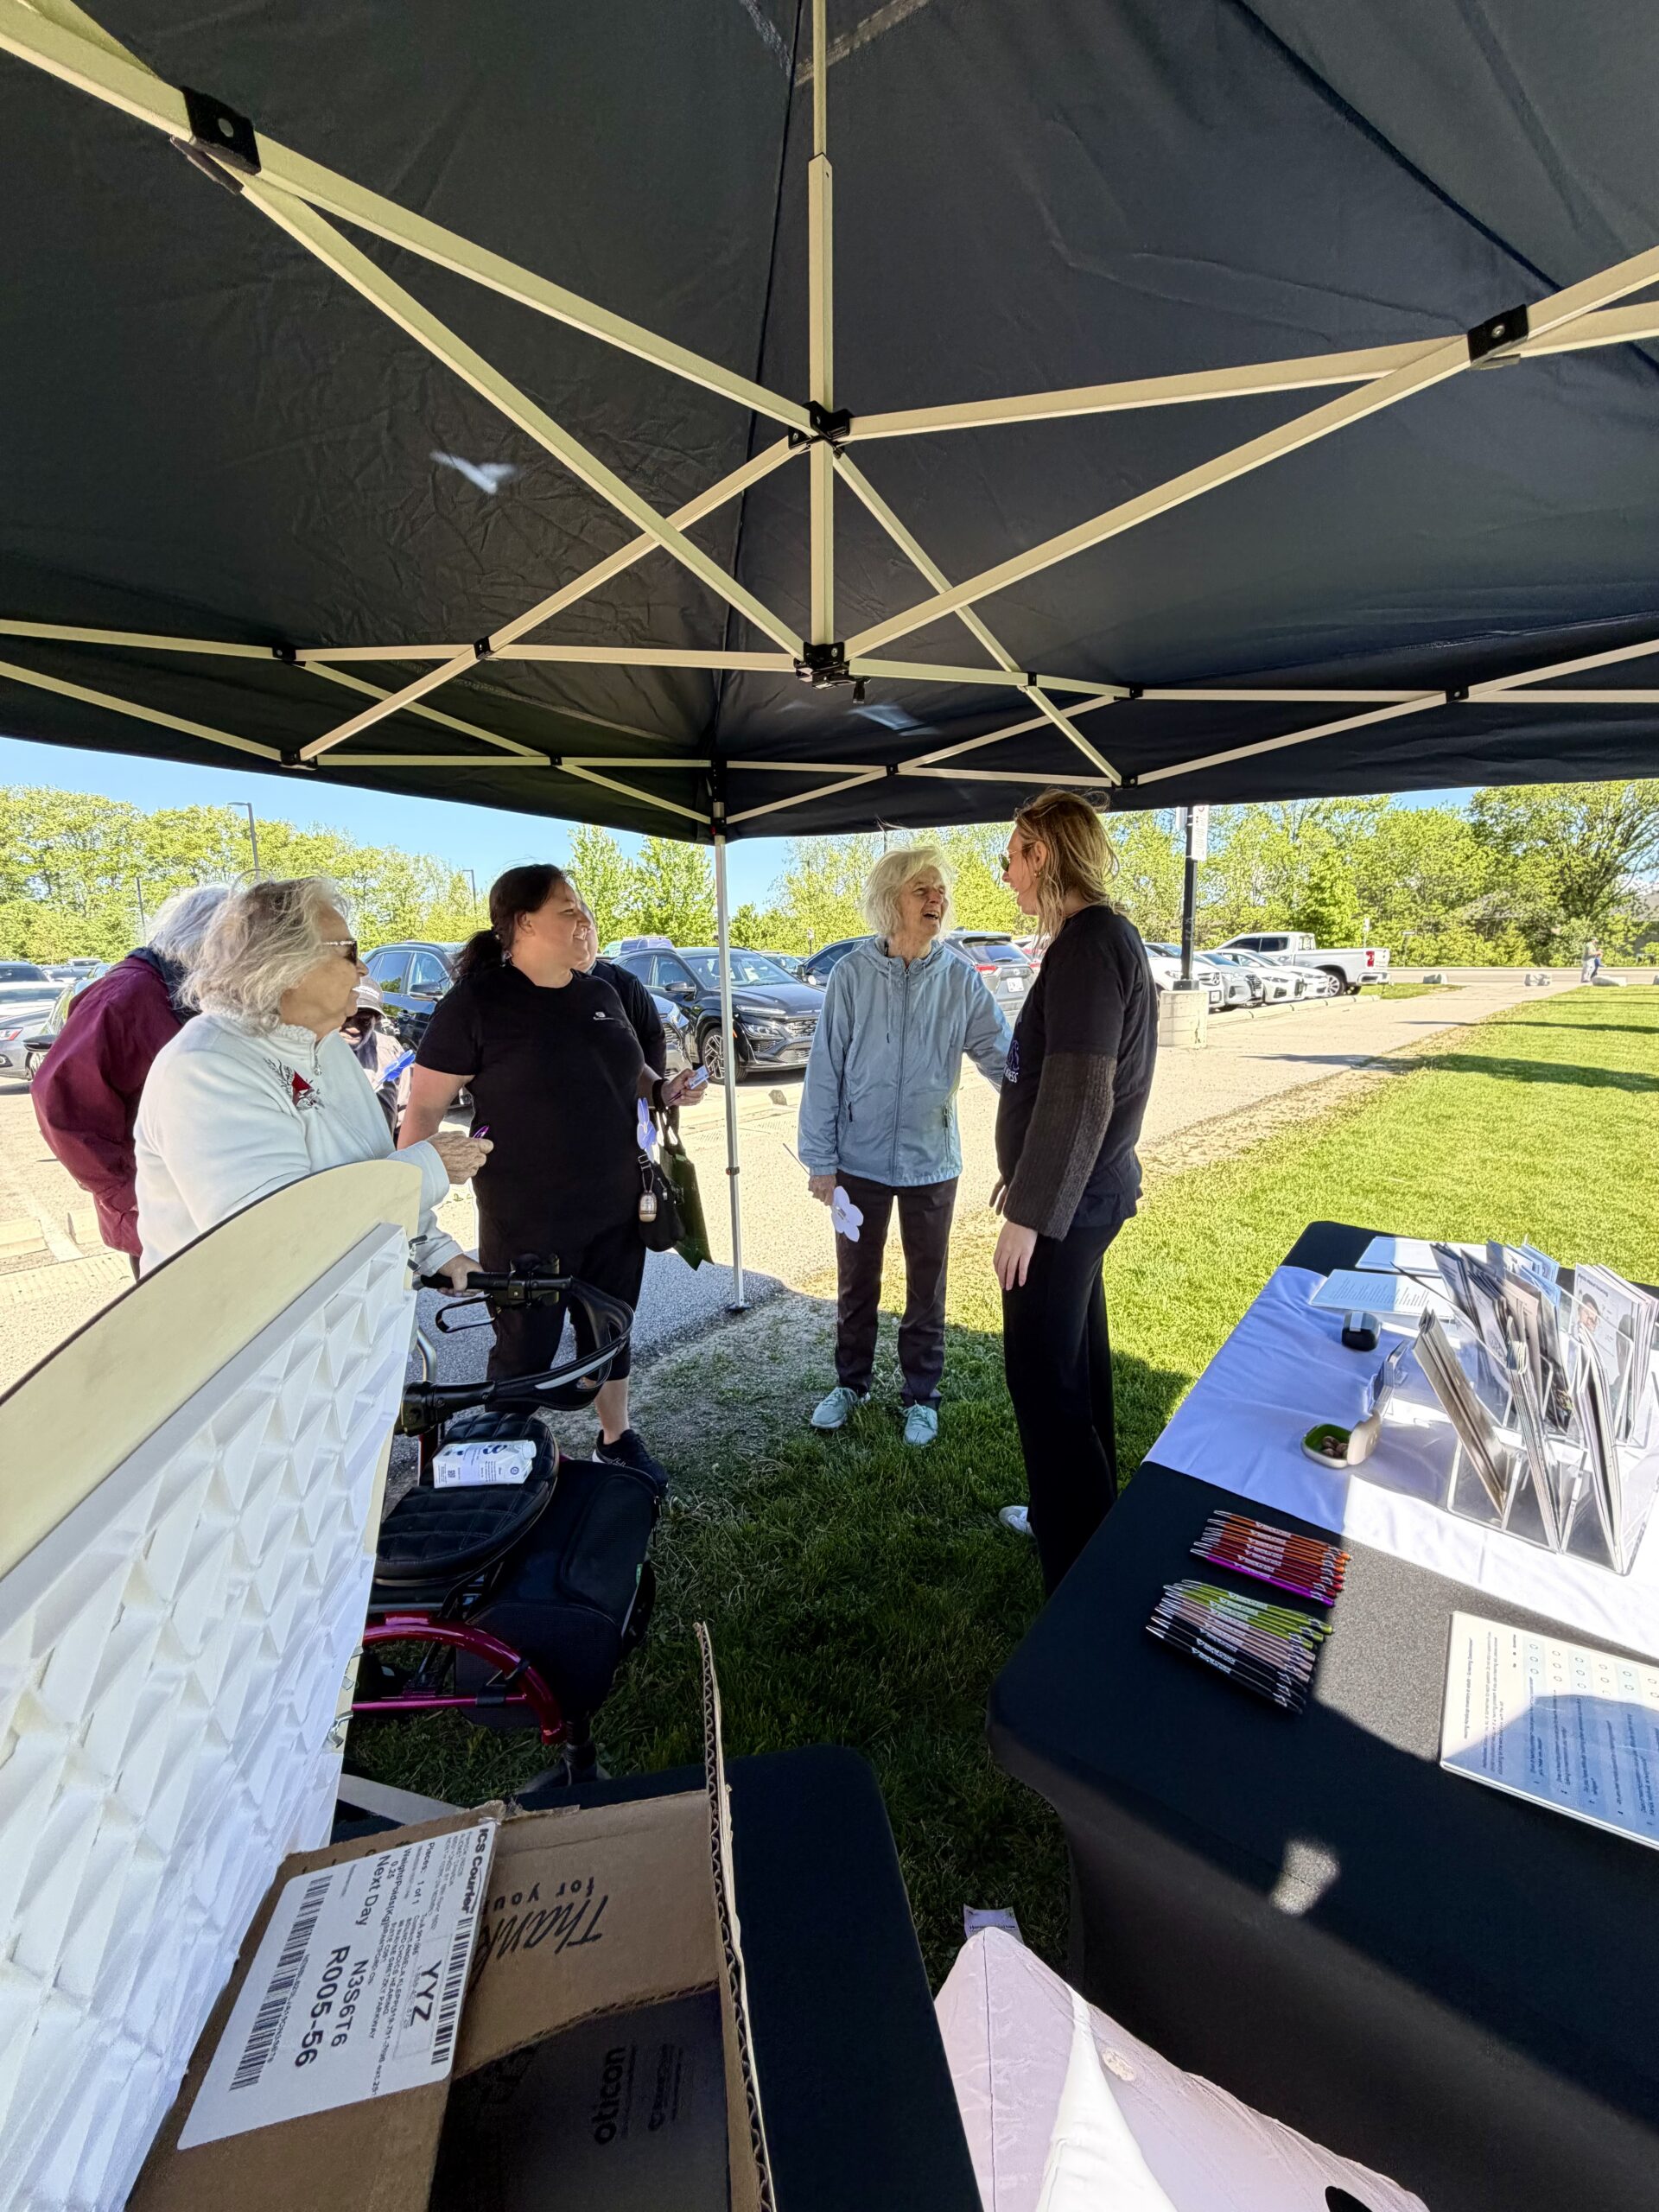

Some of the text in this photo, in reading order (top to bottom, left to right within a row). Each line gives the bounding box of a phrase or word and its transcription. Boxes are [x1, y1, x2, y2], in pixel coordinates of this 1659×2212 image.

[386, 1860, 399, 1879] 0.25
[420, 1841, 435, 1873] Pieces:
[474, 1827, 489, 1853] ICS
[355, 1854, 391, 1926] Next Day
[414, 1887, 422, 1897] of
[461, 1855, 483, 1914] Courier
[556, 1876, 595, 1898] for
[295, 1946, 350, 2067] R005-56
[331, 1960, 369, 2047] N3S6T6
[410, 1961, 442, 2026] YYZ
[591, 2045, 626, 2145] oticon
